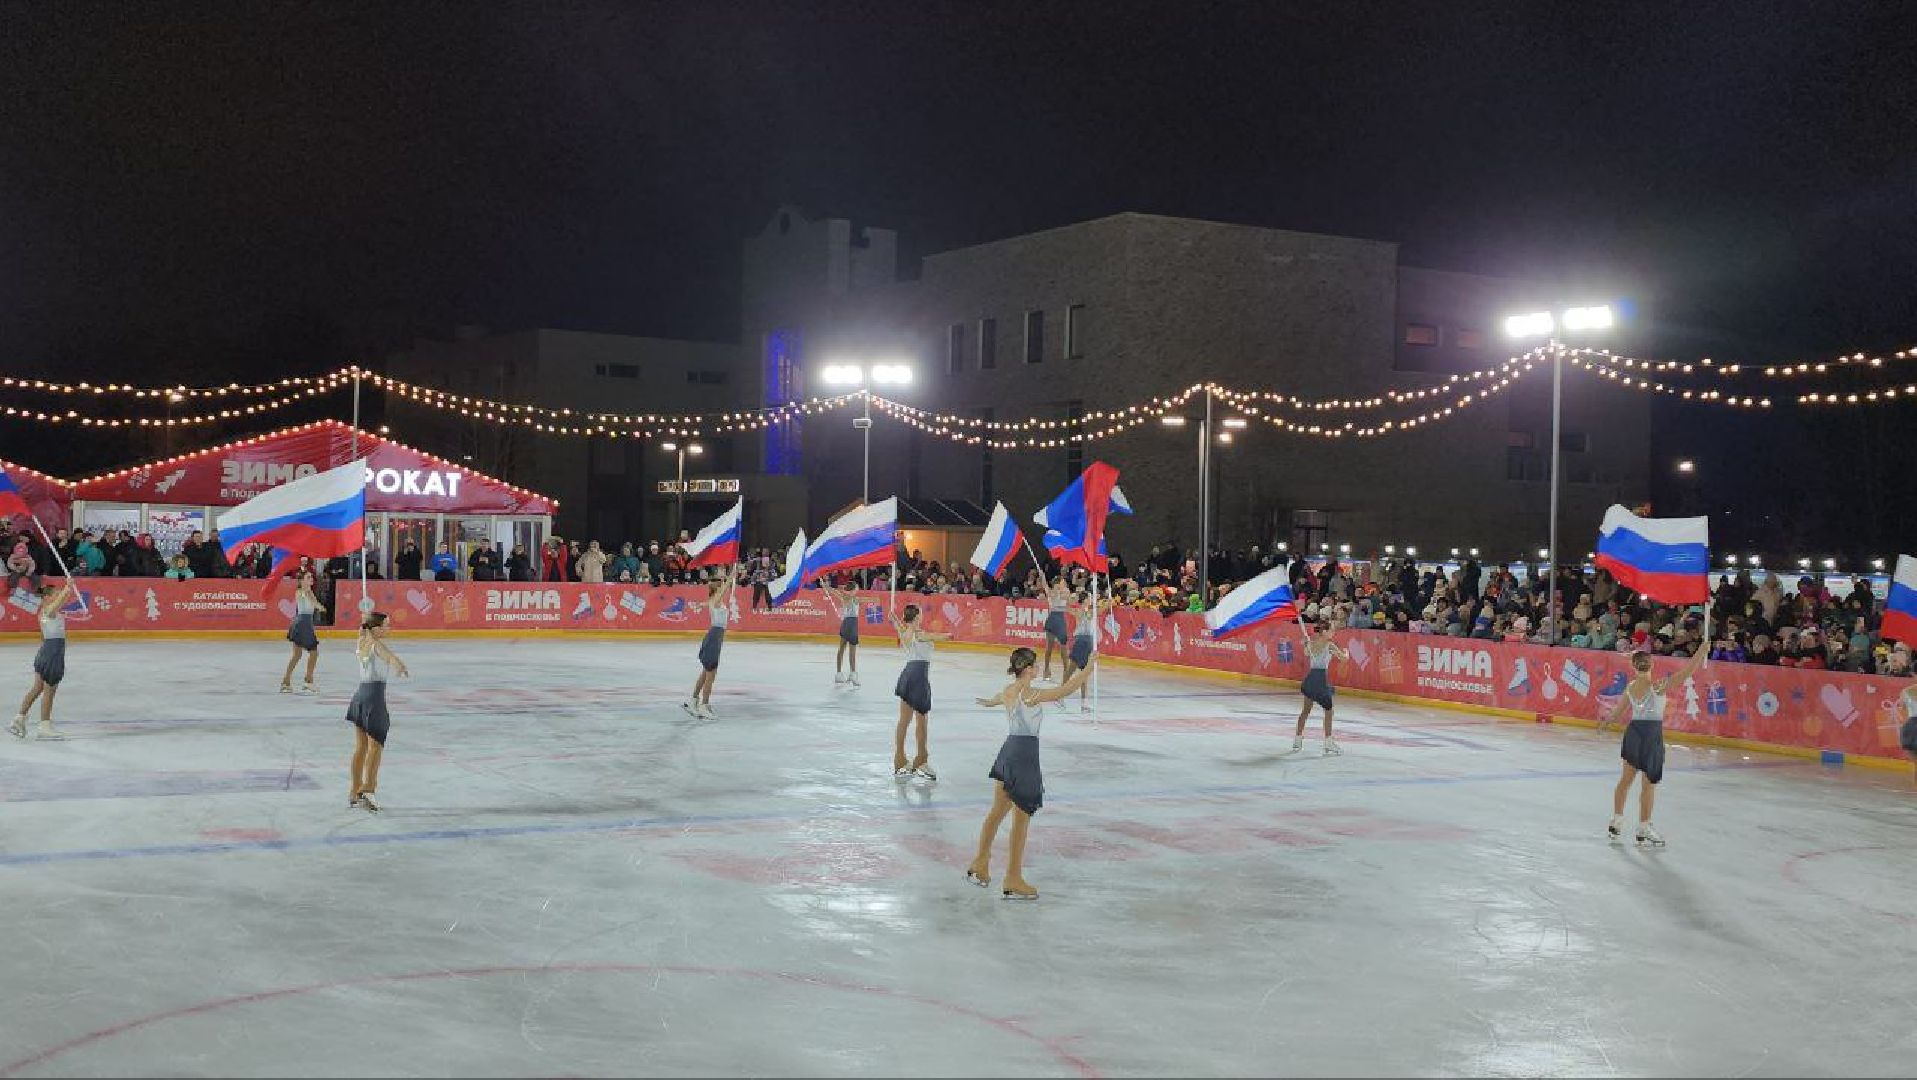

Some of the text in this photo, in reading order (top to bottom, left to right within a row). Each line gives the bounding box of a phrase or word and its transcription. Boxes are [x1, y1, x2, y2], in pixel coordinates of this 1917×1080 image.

[486, 589, 561, 609] ЗИМА
[1005, 605, 1049, 627] ЗИМ
[1417, 646, 1493, 678] ЗИМА
